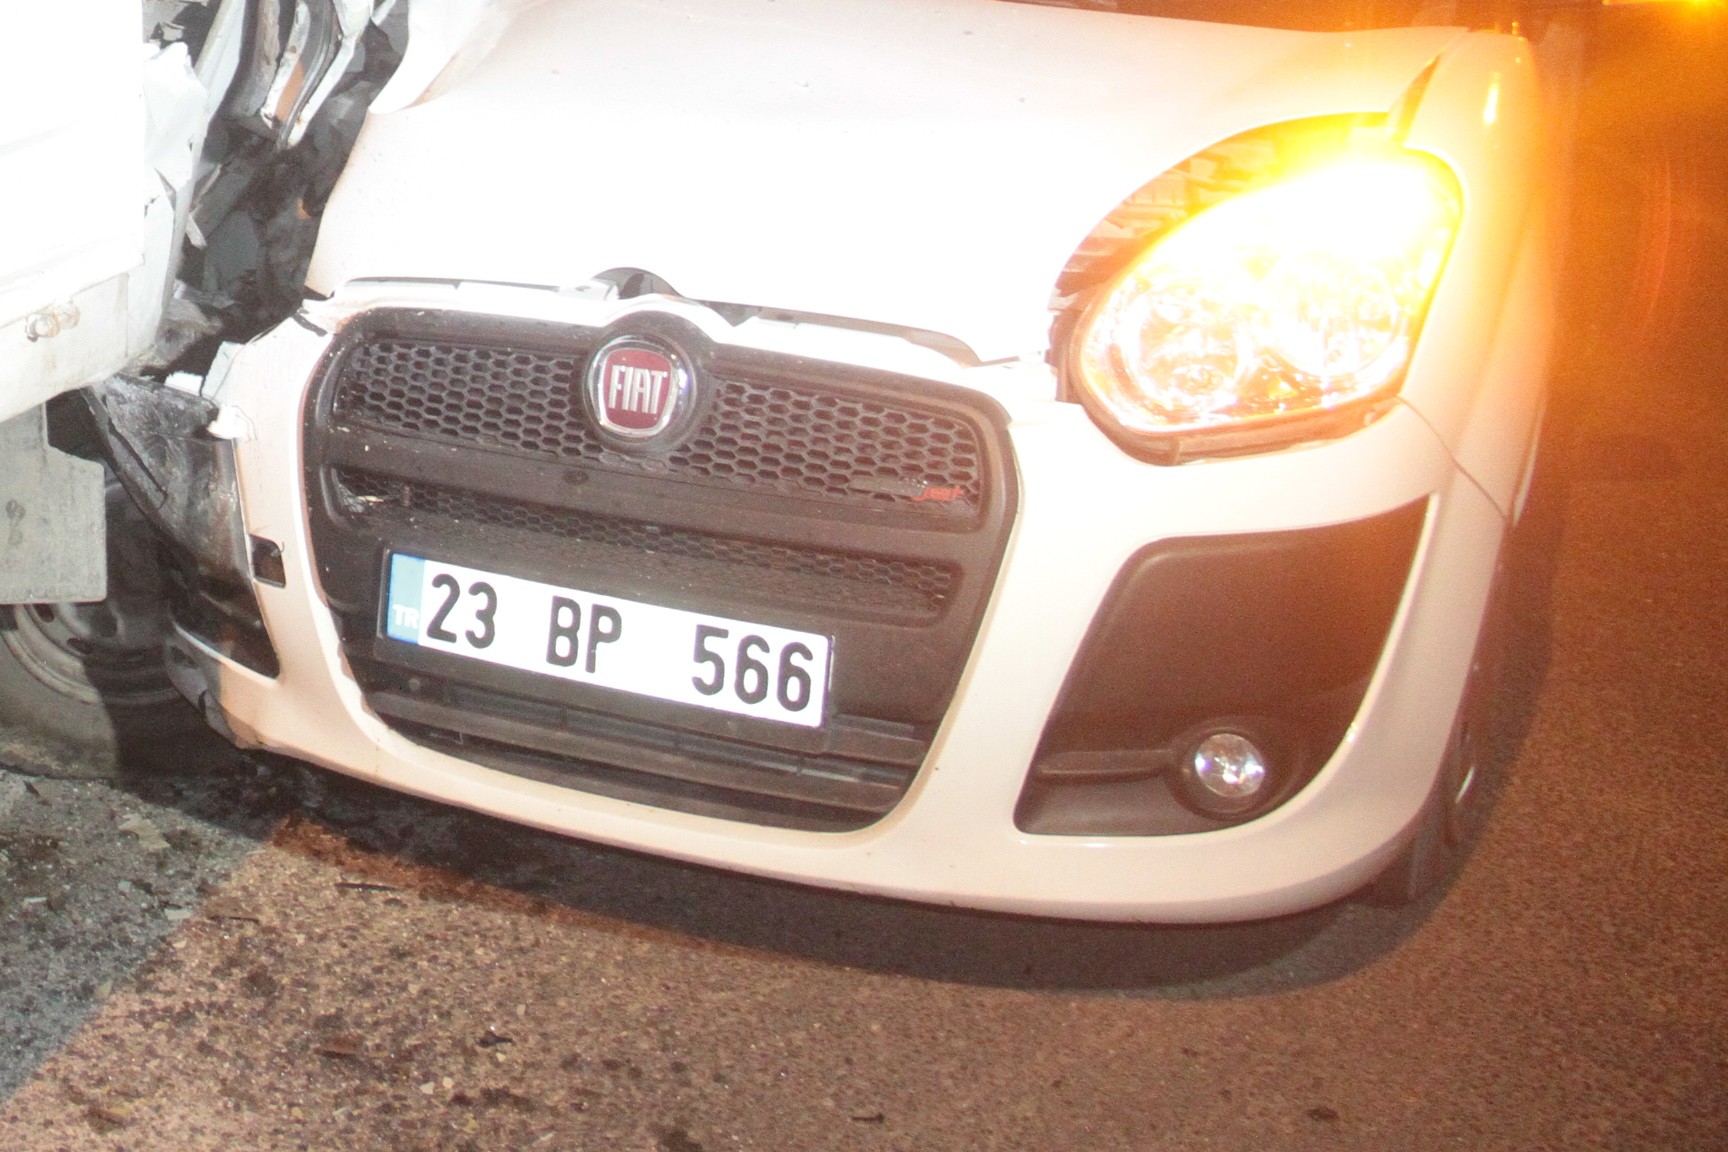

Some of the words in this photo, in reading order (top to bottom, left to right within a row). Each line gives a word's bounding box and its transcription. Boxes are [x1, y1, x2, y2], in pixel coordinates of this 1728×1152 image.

[608, 364, 668, 415] FIAT
[392, 604, 420, 629] TR
[426, 573, 497, 649] 23
[546, 595, 622, 674] BP
[691, 624, 814, 712] 566
